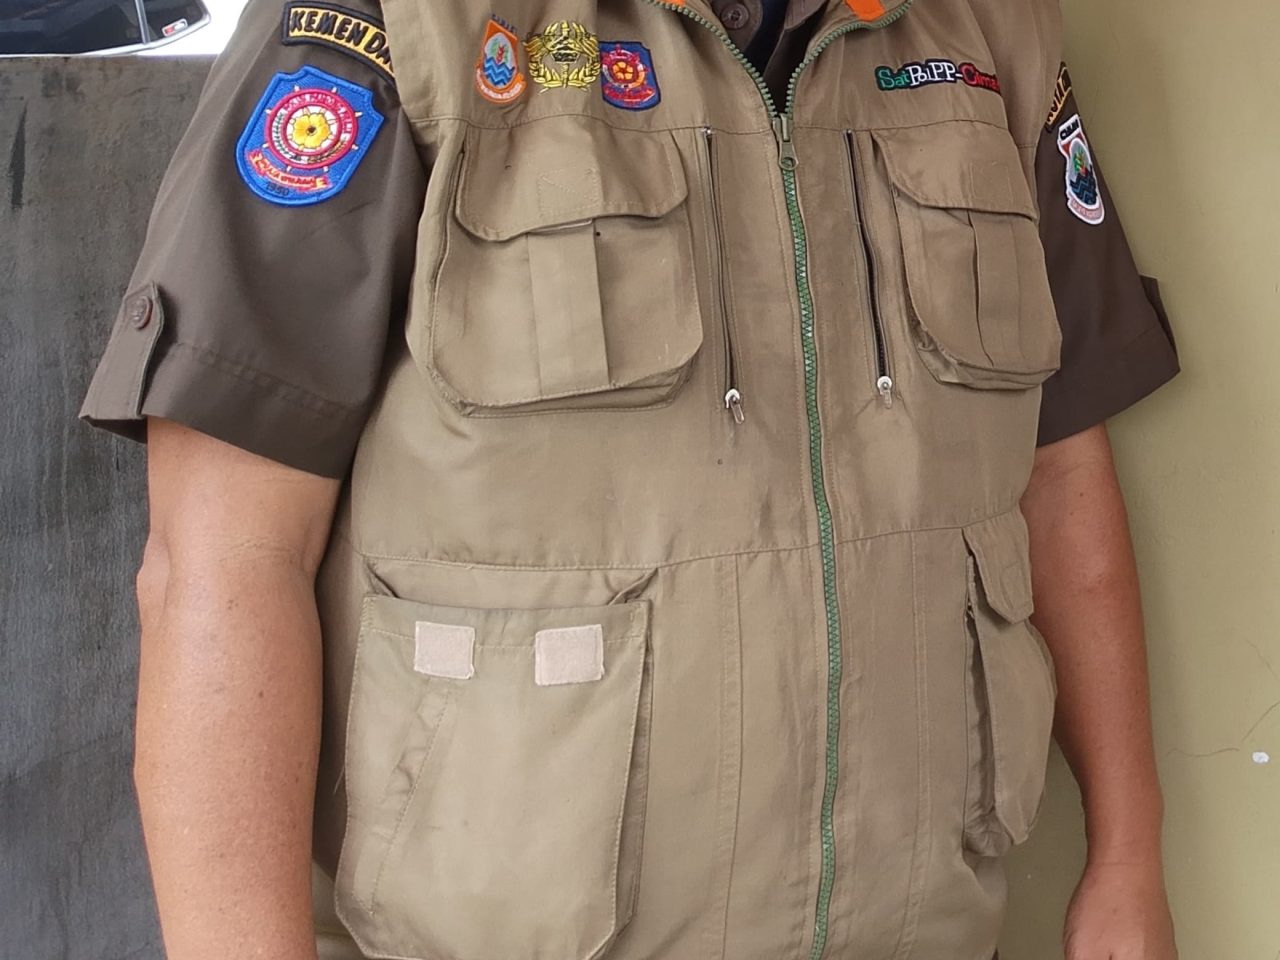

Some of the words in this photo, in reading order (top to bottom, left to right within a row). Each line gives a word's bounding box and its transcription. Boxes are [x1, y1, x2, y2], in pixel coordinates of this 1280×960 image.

[291, 10, 370, 46] KEMEN
[364, 31, 393, 69] DA
[878, 61, 1000, 90] SatPolPP-Cima
